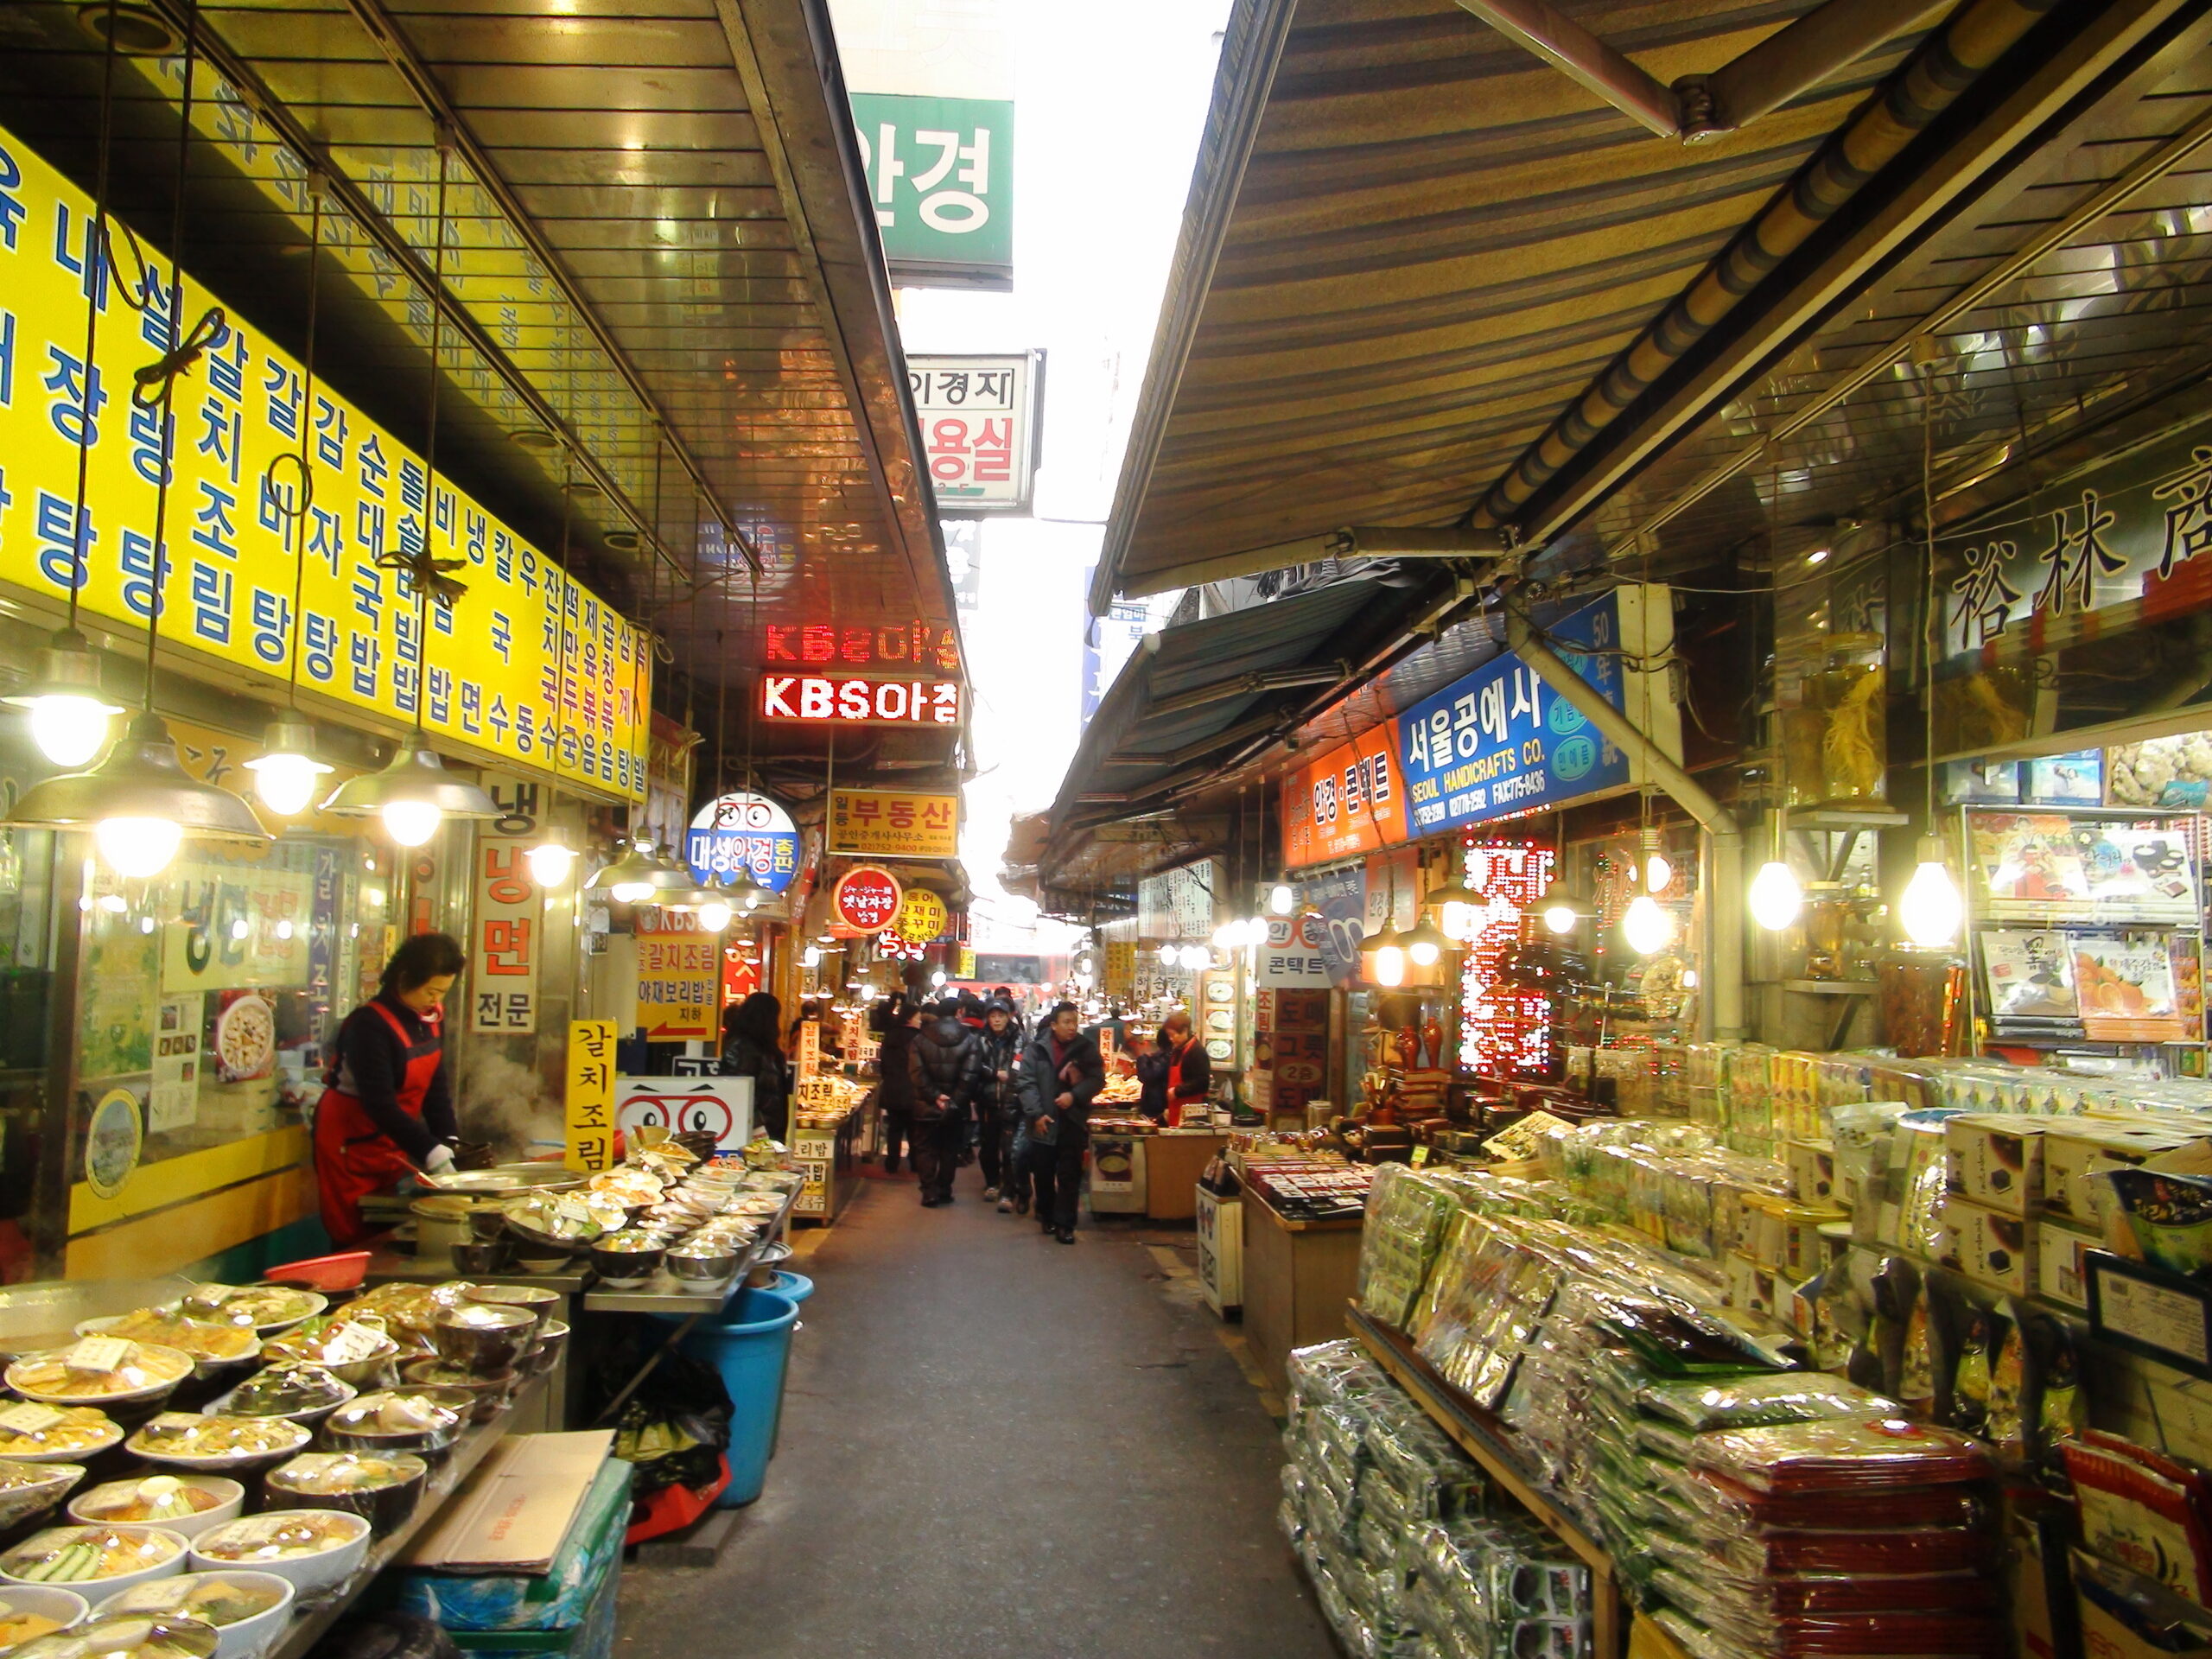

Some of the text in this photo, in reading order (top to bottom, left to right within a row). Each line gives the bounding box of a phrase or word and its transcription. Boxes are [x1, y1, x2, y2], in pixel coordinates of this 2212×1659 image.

[38, 203, 110, 588] 내장탕
[192, 313, 248, 645] 갈치조림
[918, 418, 1013, 481] 용실
[253, 357, 303, 664] 갈비탕
[306, 397, 347, 681] 감자탕
[352, 435, 388, 697] 순대국밥
[461, 507, 486, 734] 냉면
[490, 530, 514, 742] 칼국수
[516, 552, 537, 753] 우동
[540, 567, 561, 760] 잔치국수
[1409, 667, 1541, 773] 서울공예사
[1411, 738, 1545, 804] SEOUL HANDICRAFTS CO.
[852, 799, 951, 830] 부동산
[477, 993, 531, 1027] 전문
[649, 943, 715, 972] 갈치조림
[679, 1007, 702, 1022] 지하
[1268, 957, 1324, 975] 콘택트
[573, 1024, 613, 1171] 갈치조림
